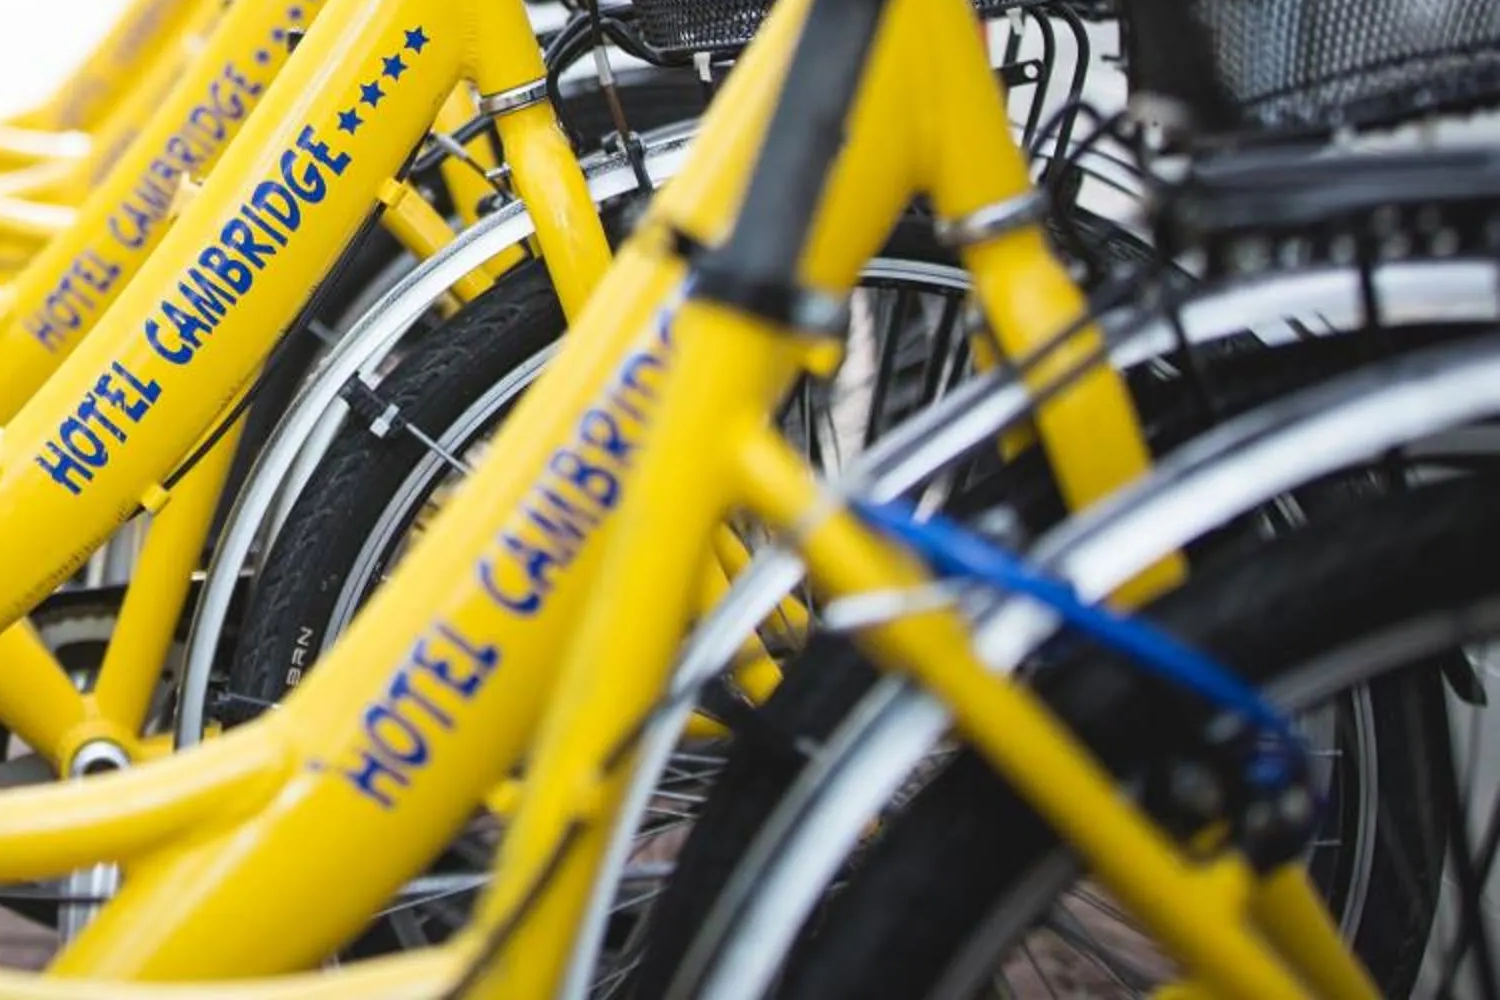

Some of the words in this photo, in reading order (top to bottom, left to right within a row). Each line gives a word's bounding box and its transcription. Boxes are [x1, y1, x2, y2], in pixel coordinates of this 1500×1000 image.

[24, 249, 121, 353] HOTEL
[108, 63, 263, 249] CAMBRIDGE
[34, 360, 162, 495] HOTEL
[145, 125, 351, 365] CAMBRIDGE
[343, 621, 500, 808] HOTEL
[476, 266, 700, 618] CAMBRID
